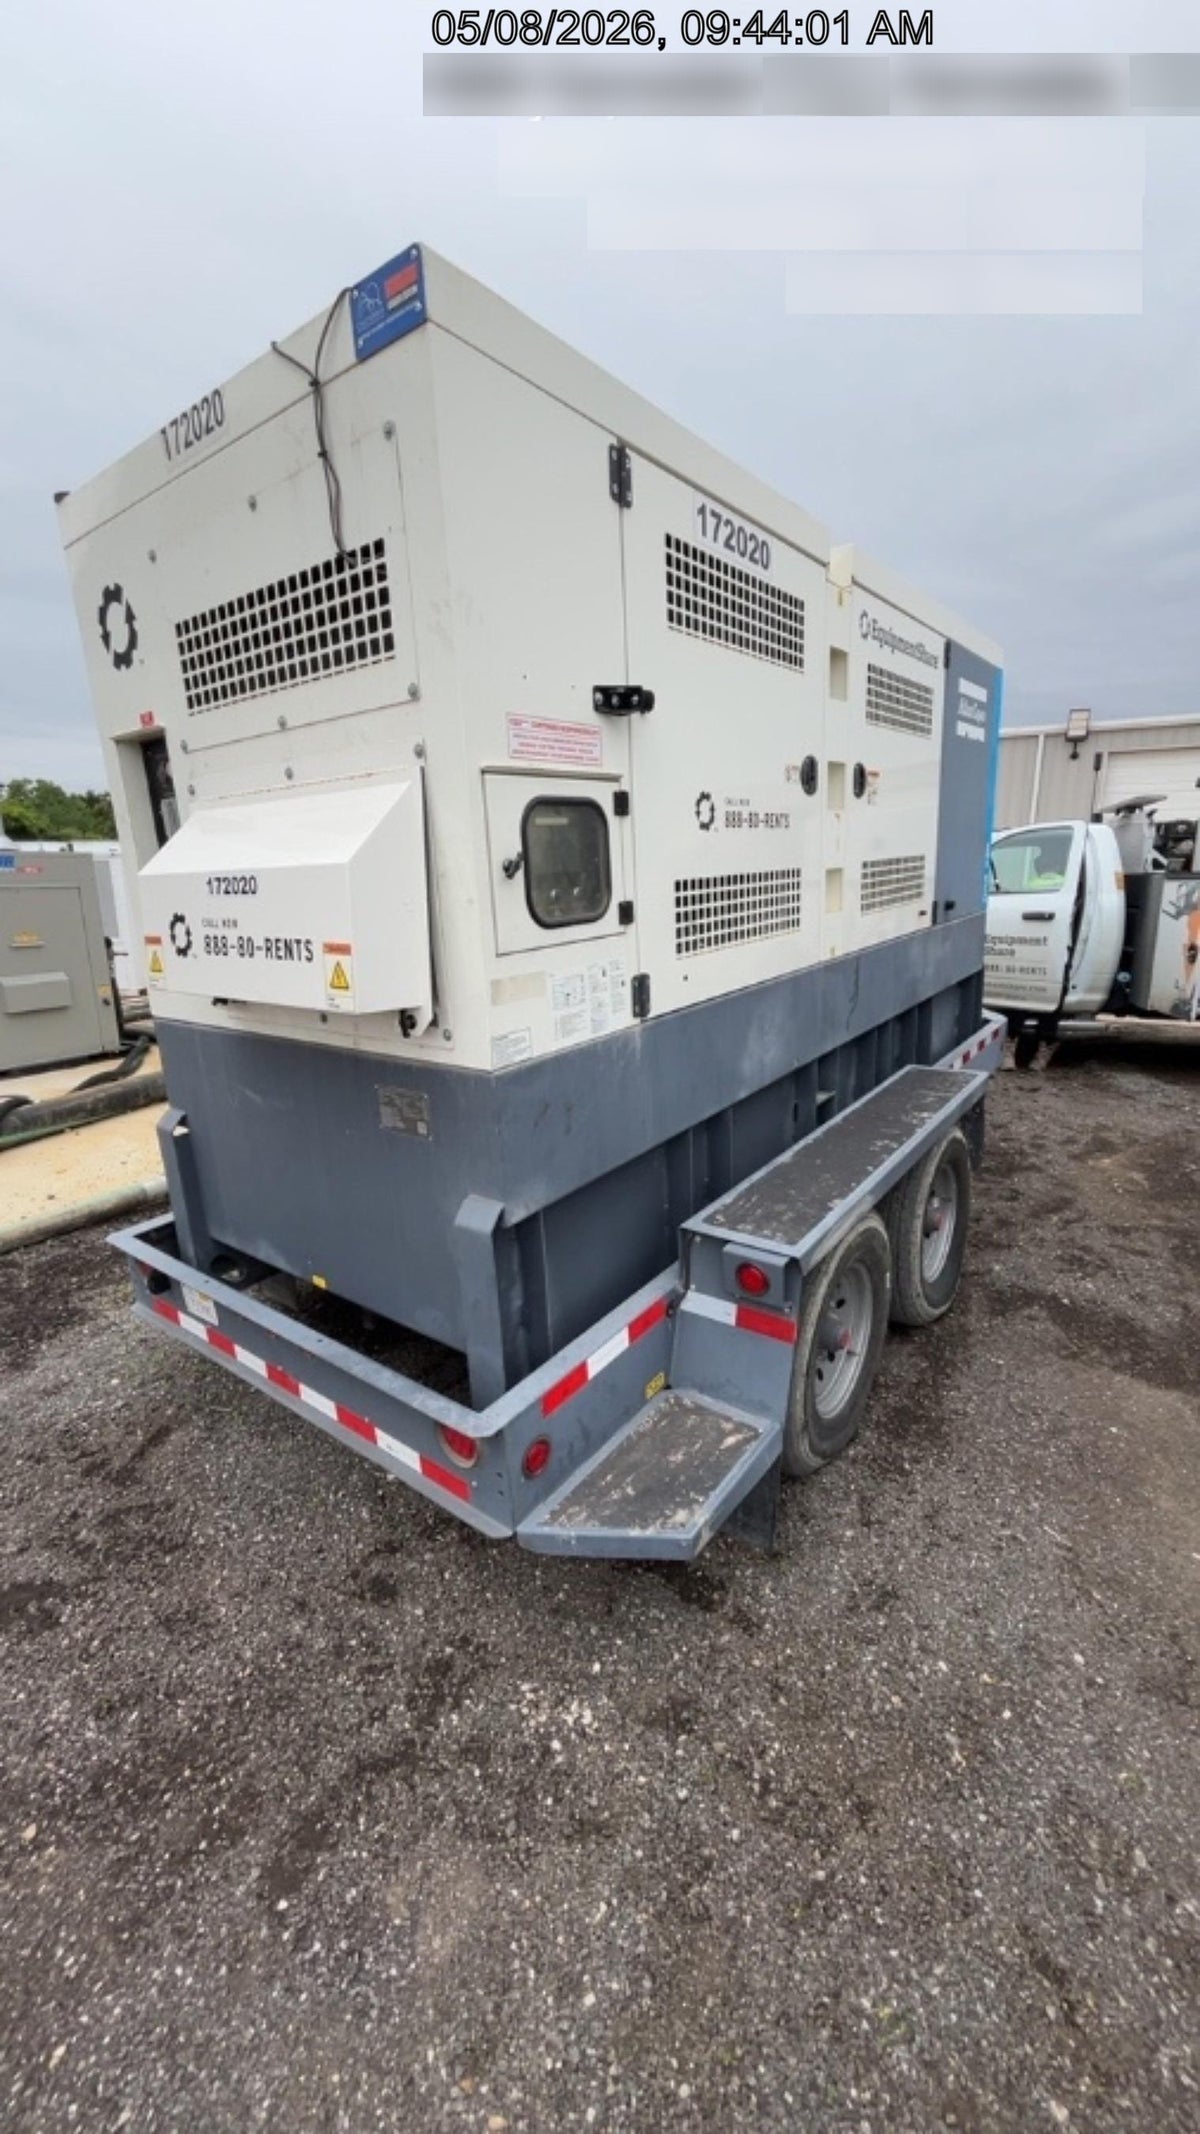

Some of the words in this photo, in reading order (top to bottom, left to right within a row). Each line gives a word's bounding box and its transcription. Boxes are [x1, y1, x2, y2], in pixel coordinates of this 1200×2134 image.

[160, 388, 226, 462] 172020
[697, 502, 771, 571] 172020
[724, 809, 791, 829] 888-80-RENTS
[206, 875, 258, 897] 172020
[203, 933, 315, 964] 888-80-RENTS
